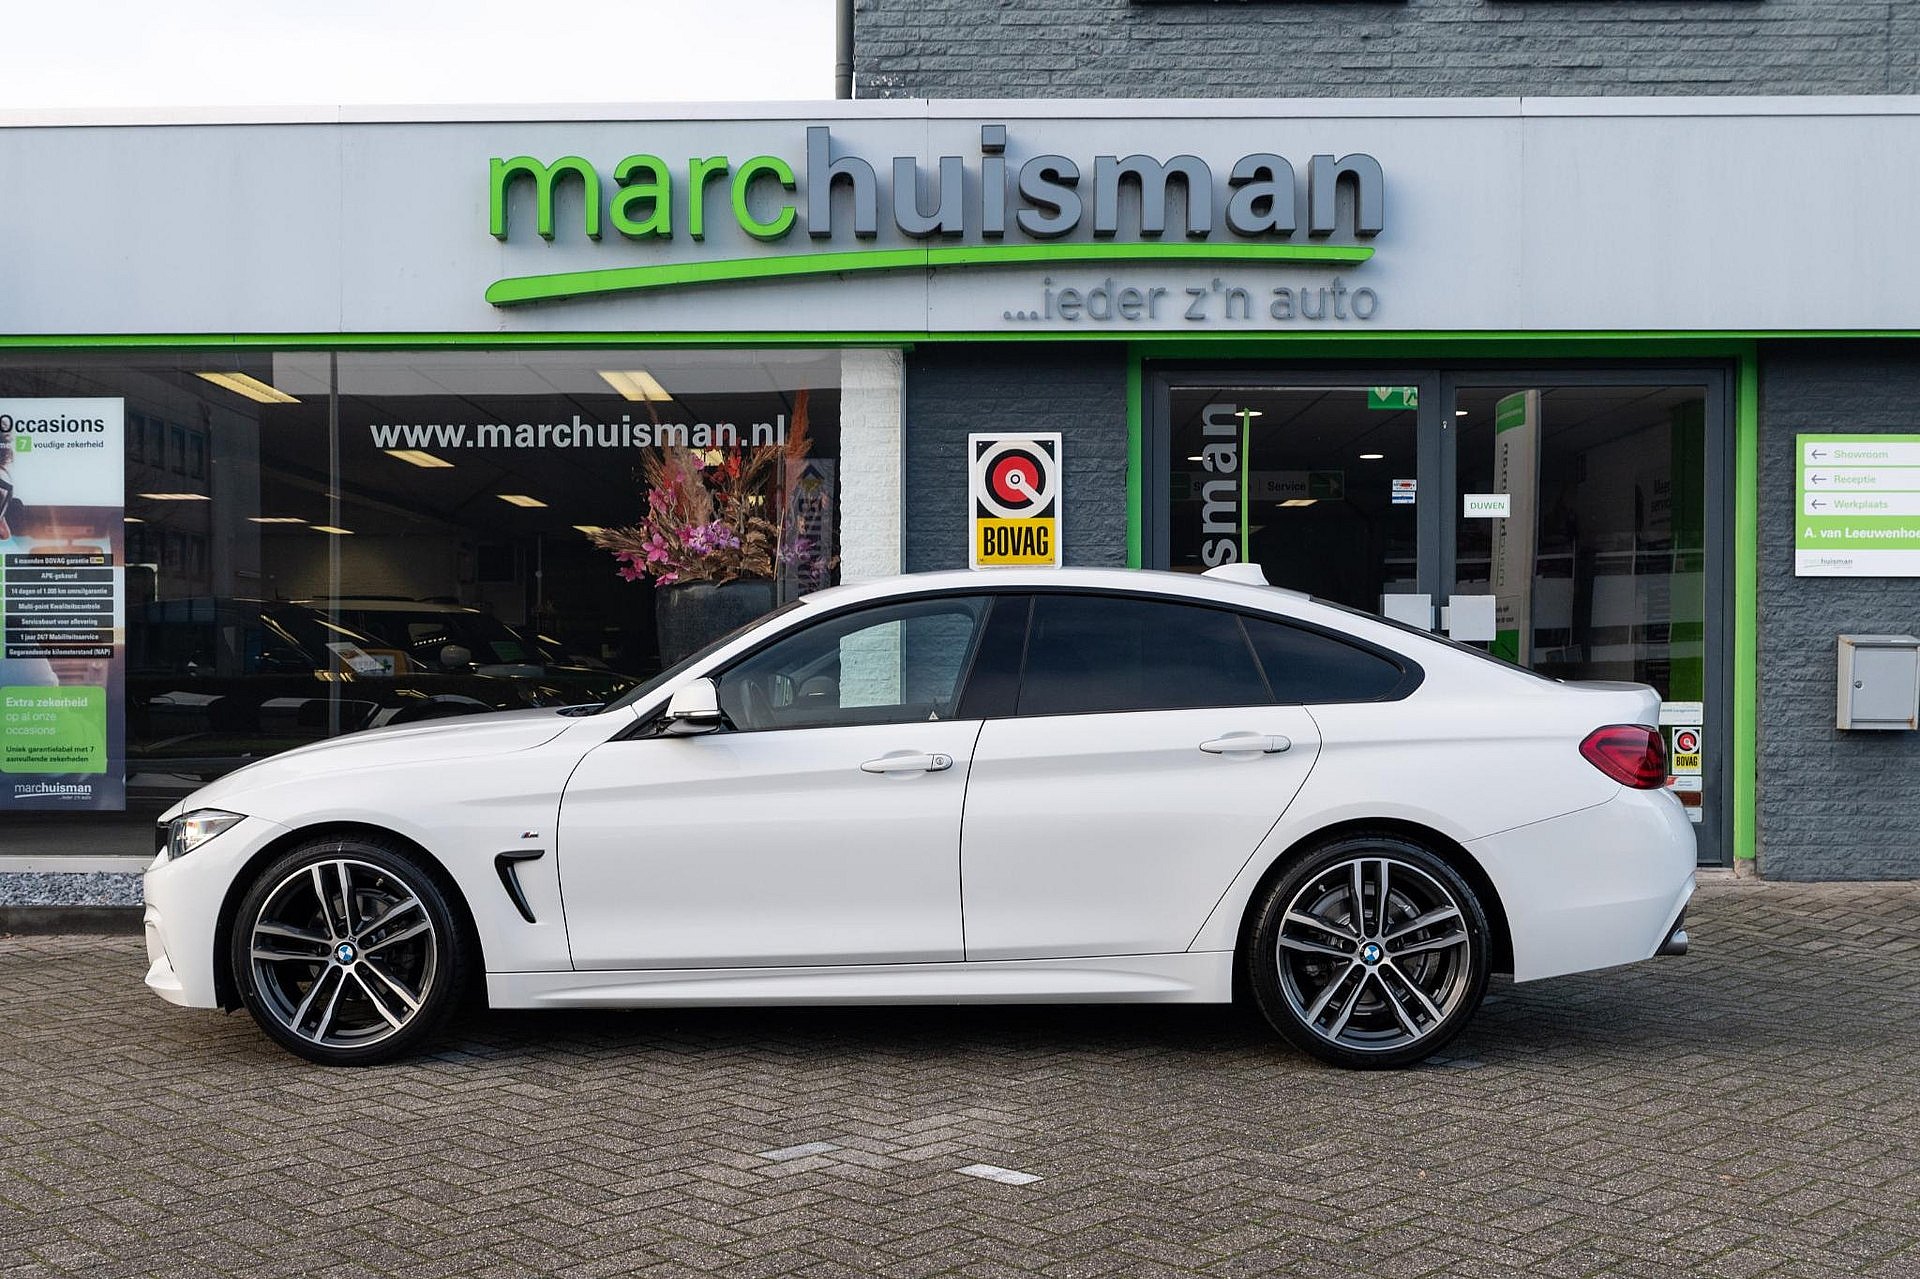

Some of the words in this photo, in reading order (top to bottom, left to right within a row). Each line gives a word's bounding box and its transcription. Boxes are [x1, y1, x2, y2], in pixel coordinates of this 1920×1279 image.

[489, 125, 1384, 240] marchuisman
[1185, 278, 1250, 321] z'n
[1270, 277, 1379, 321] auto
[0, 414, 104, 433] Occasions
[370, 414, 785, 449] www.marchuisman.nl
[33, 441, 65, 450] voudige
[66, 440, 104, 449] zekerheid
[1834, 450, 1889, 459] Showroom
[1202, 403, 1238, 567] sman
[1834, 475, 1877, 485] Receptie
[1470, 501, 1505, 510] DUWEN
[1834, 500, 1888, 510] Werkplaats
[1804, 527, 1816, 538] A.
[1820, 529, 1841, 538] van
[983, 526, 1049, 556] BOVAG
[5, 697, 34, 707] Extra
[36, 697, 88, 707] zekerheid
[5, 713, 19, 722] op
[32, 713, 57, 721] onze
[5, 726, 56, 735] occasions
[1676, 756, 1698, 767] BOVAG
[14, 782, 92, 793] marchuisman
